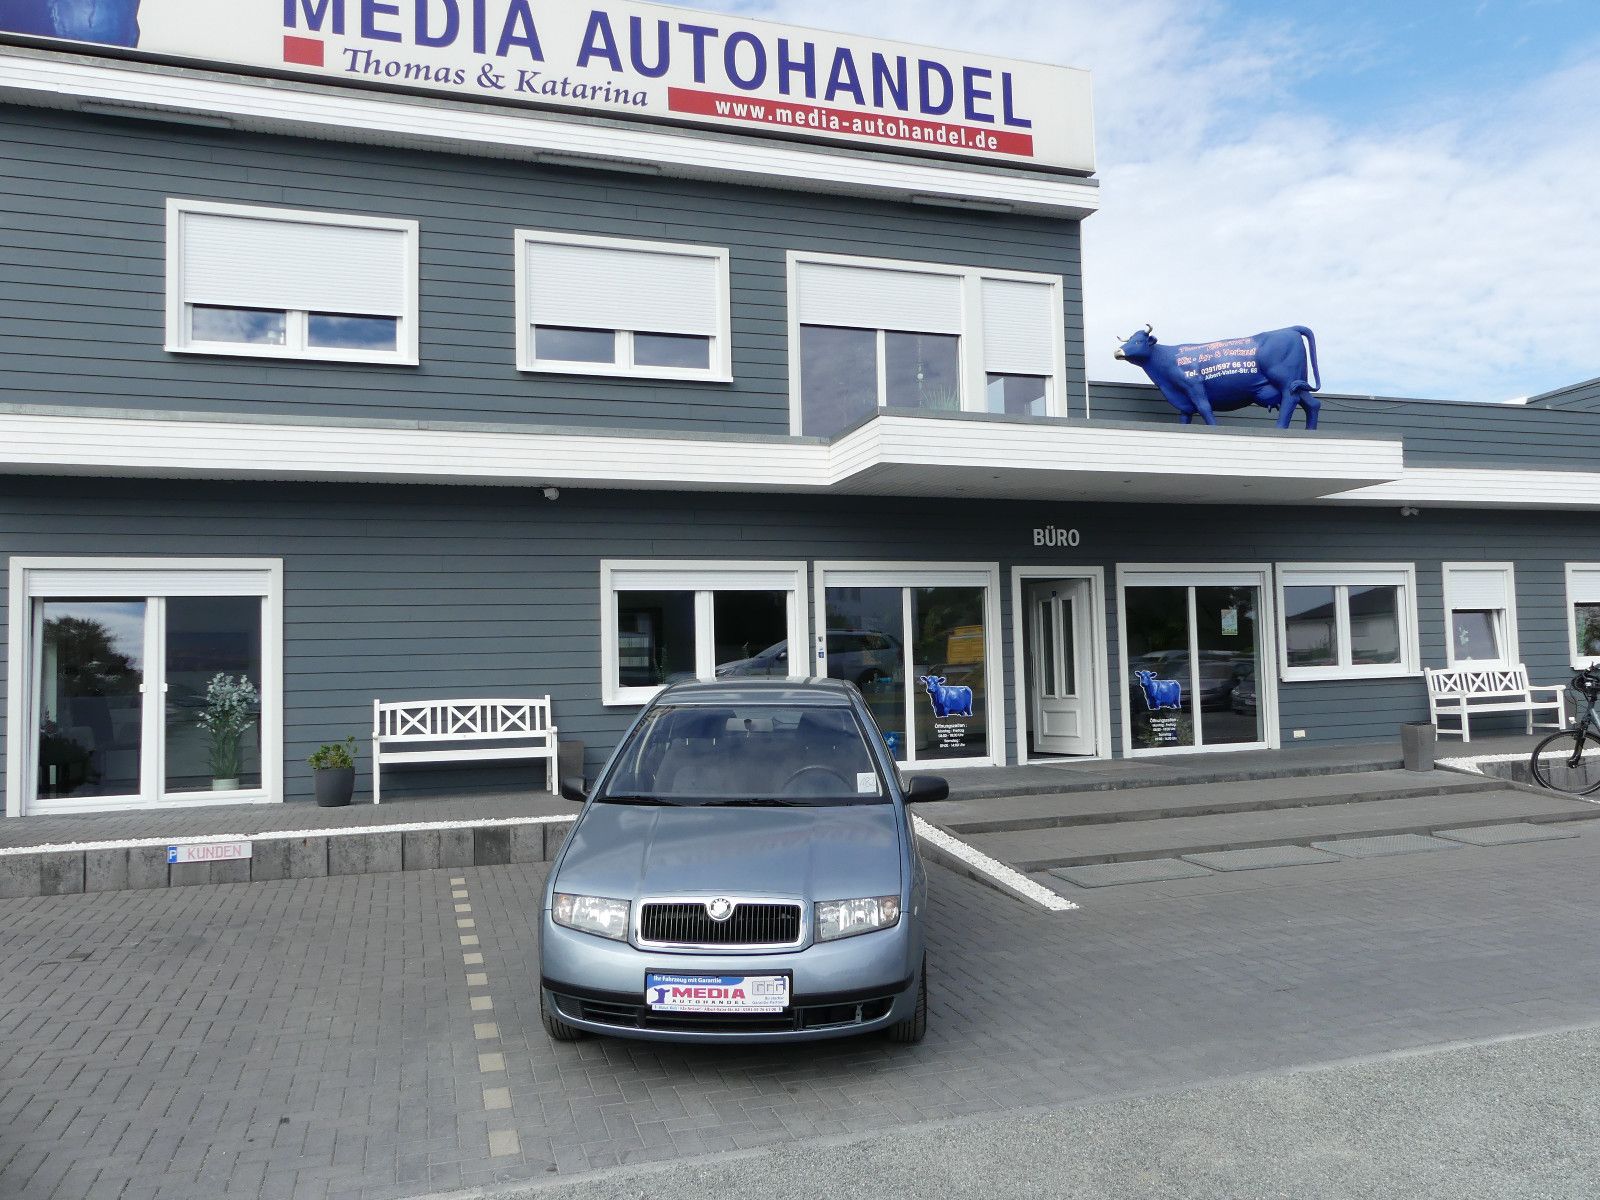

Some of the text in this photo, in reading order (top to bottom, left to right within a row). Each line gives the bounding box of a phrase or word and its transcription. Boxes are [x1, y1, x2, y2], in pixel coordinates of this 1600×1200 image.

[283, 0, 1032, 128] MEDIA AUTOHANDEL
[343, 47, 649, 107] Thomas & Katarina
[715, 99, 998, 150] www.media-autohandel.de
[1033, 525, 1080, 546] BÜRO
[169, 845, 242, 860] P KUNDEN
[672, 987, 746, 999] MEDIA
